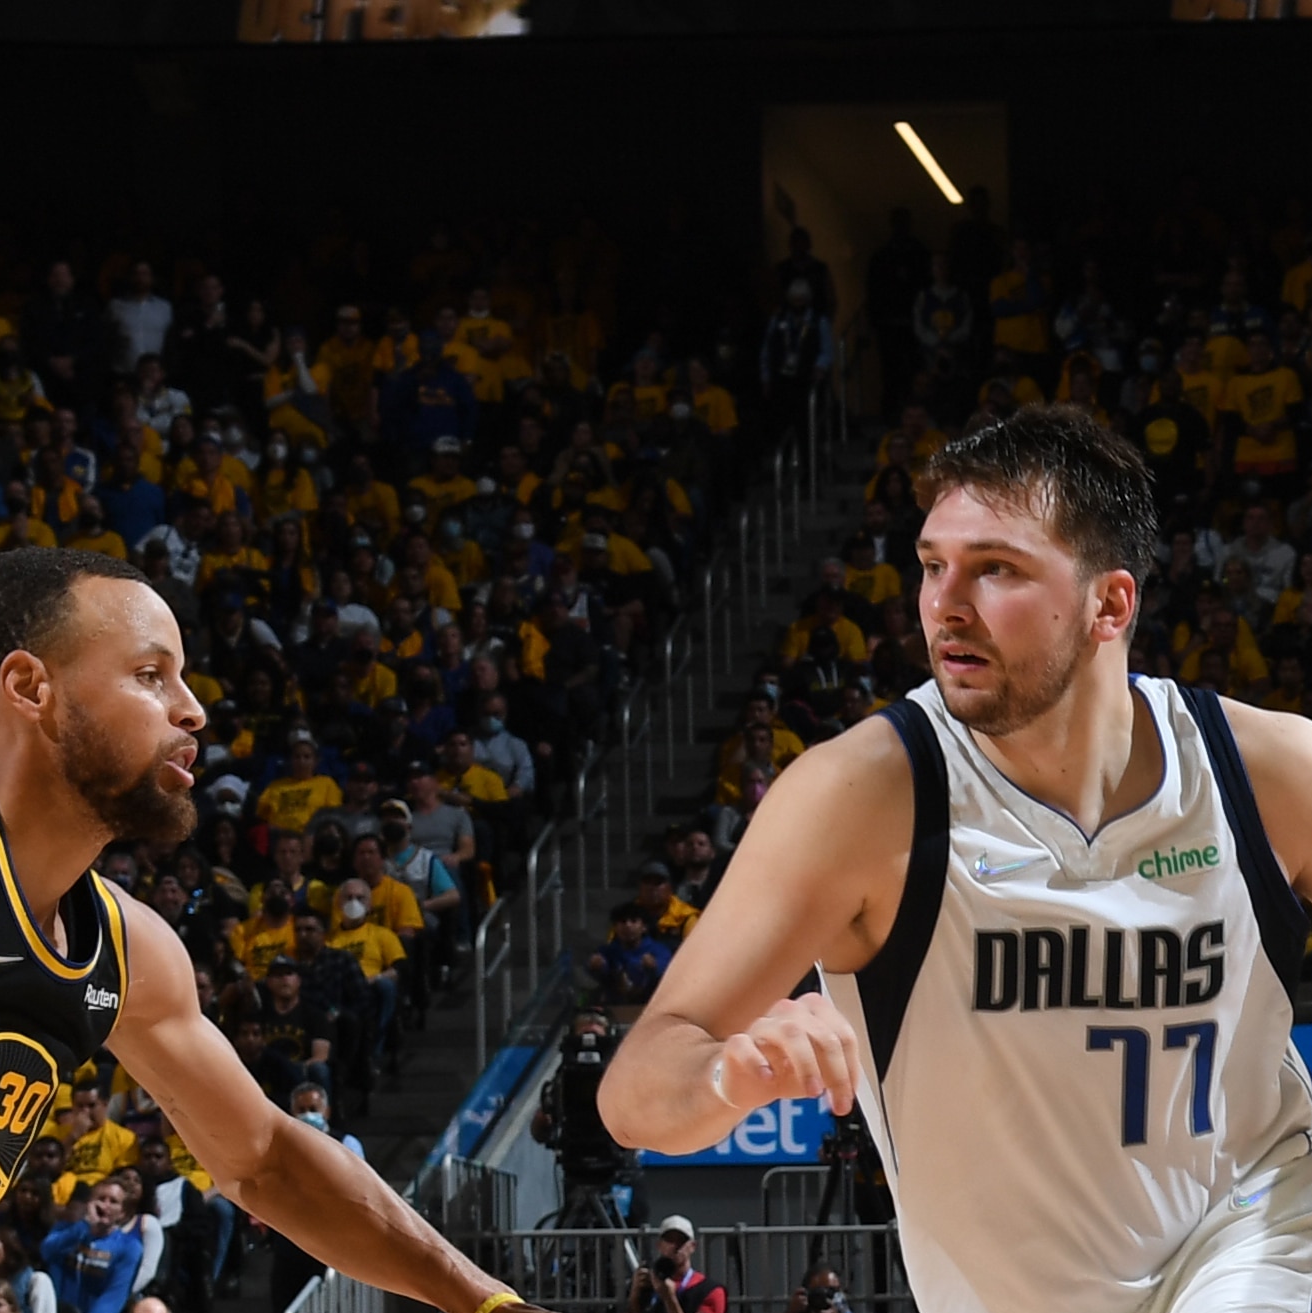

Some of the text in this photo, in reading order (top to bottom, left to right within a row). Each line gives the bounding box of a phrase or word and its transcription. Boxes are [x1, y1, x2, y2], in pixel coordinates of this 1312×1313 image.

[1138, 845, 1220, 879] chime
[972, 918, 1226, 1013] DALLAS
[1085, 1018, 1220, 1147] 77
